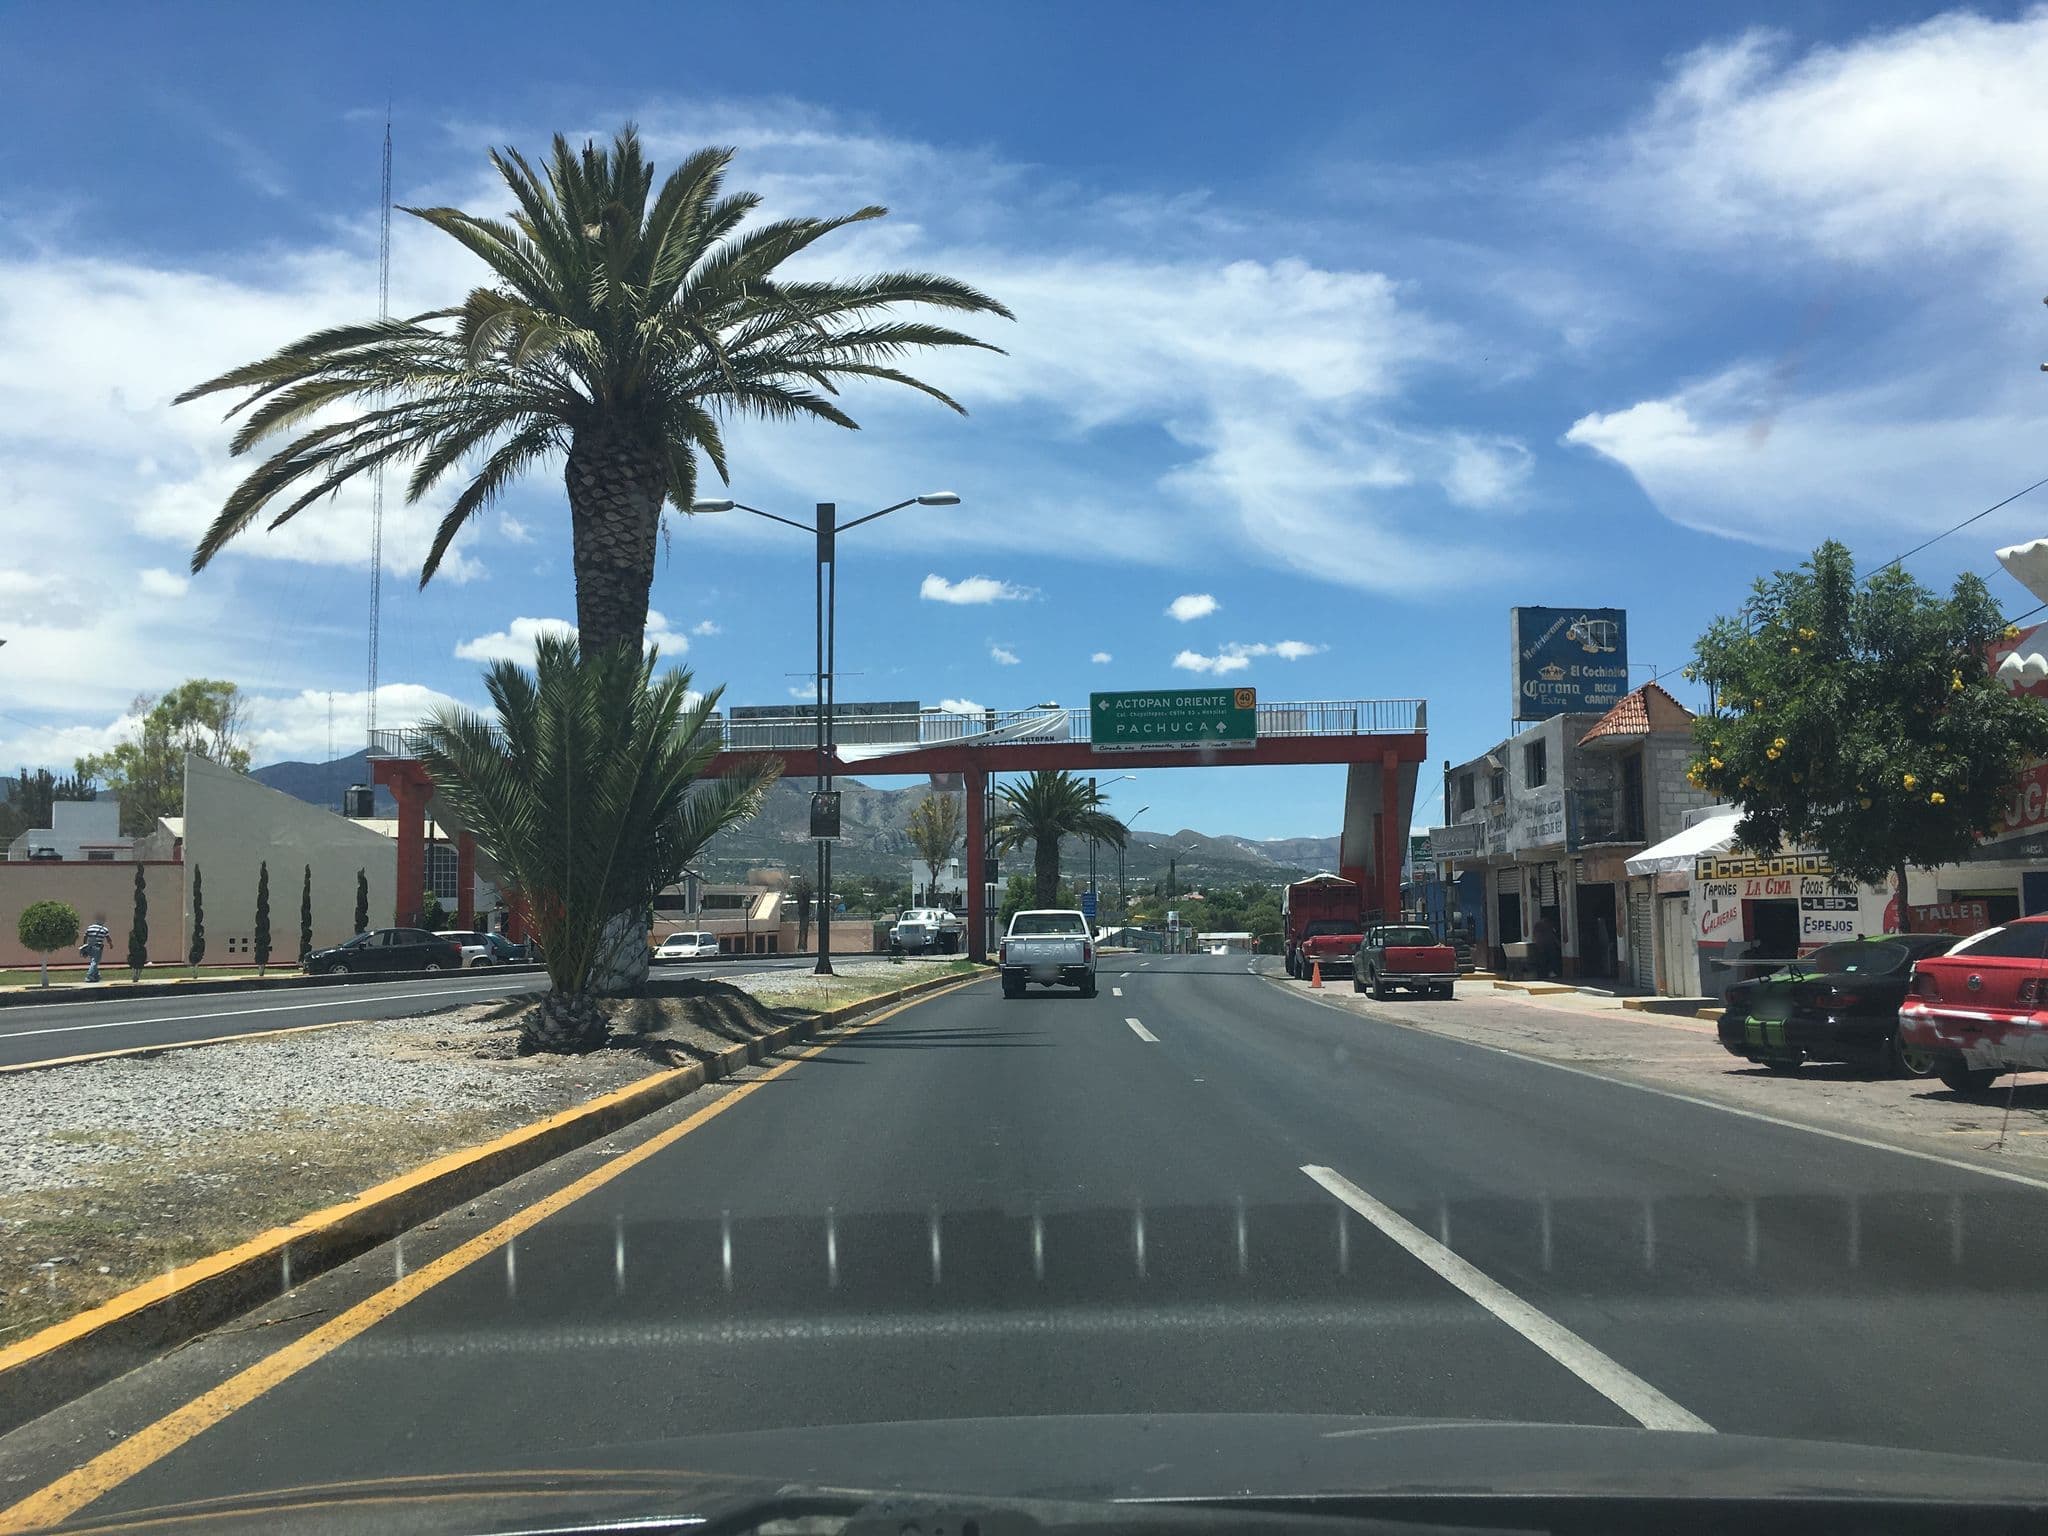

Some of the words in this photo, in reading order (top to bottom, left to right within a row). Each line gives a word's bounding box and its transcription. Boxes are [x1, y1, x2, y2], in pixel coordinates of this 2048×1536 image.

[1570, 665, 1580, 677] El
[1239, 692, 1250, 701] 40
[1522, 679, 1581, 700] Corona
[1115, 698, 1170, 709] ACTOPAN
[1176, 696, 1227, 707] ORIENTE
[1541, 695, 1567, 705] Extra
[1116, 722, 1209, 734] PACHUCA
[1697, 855, 1834, 879] ACCESORIOS
[1703, 881, 1737, 900] TAPONES
[1745, 879, 1761, 896] LA
[1765, 877, 1792, 895] CIMA
[1800, 876, 1824, 895] FOCOS
[1701, 906, 1737, 934] CALAVERAS
[1916, 904, 1984, 922] TALLER
[1804, 916, 1854, 934] ESPEJOS
